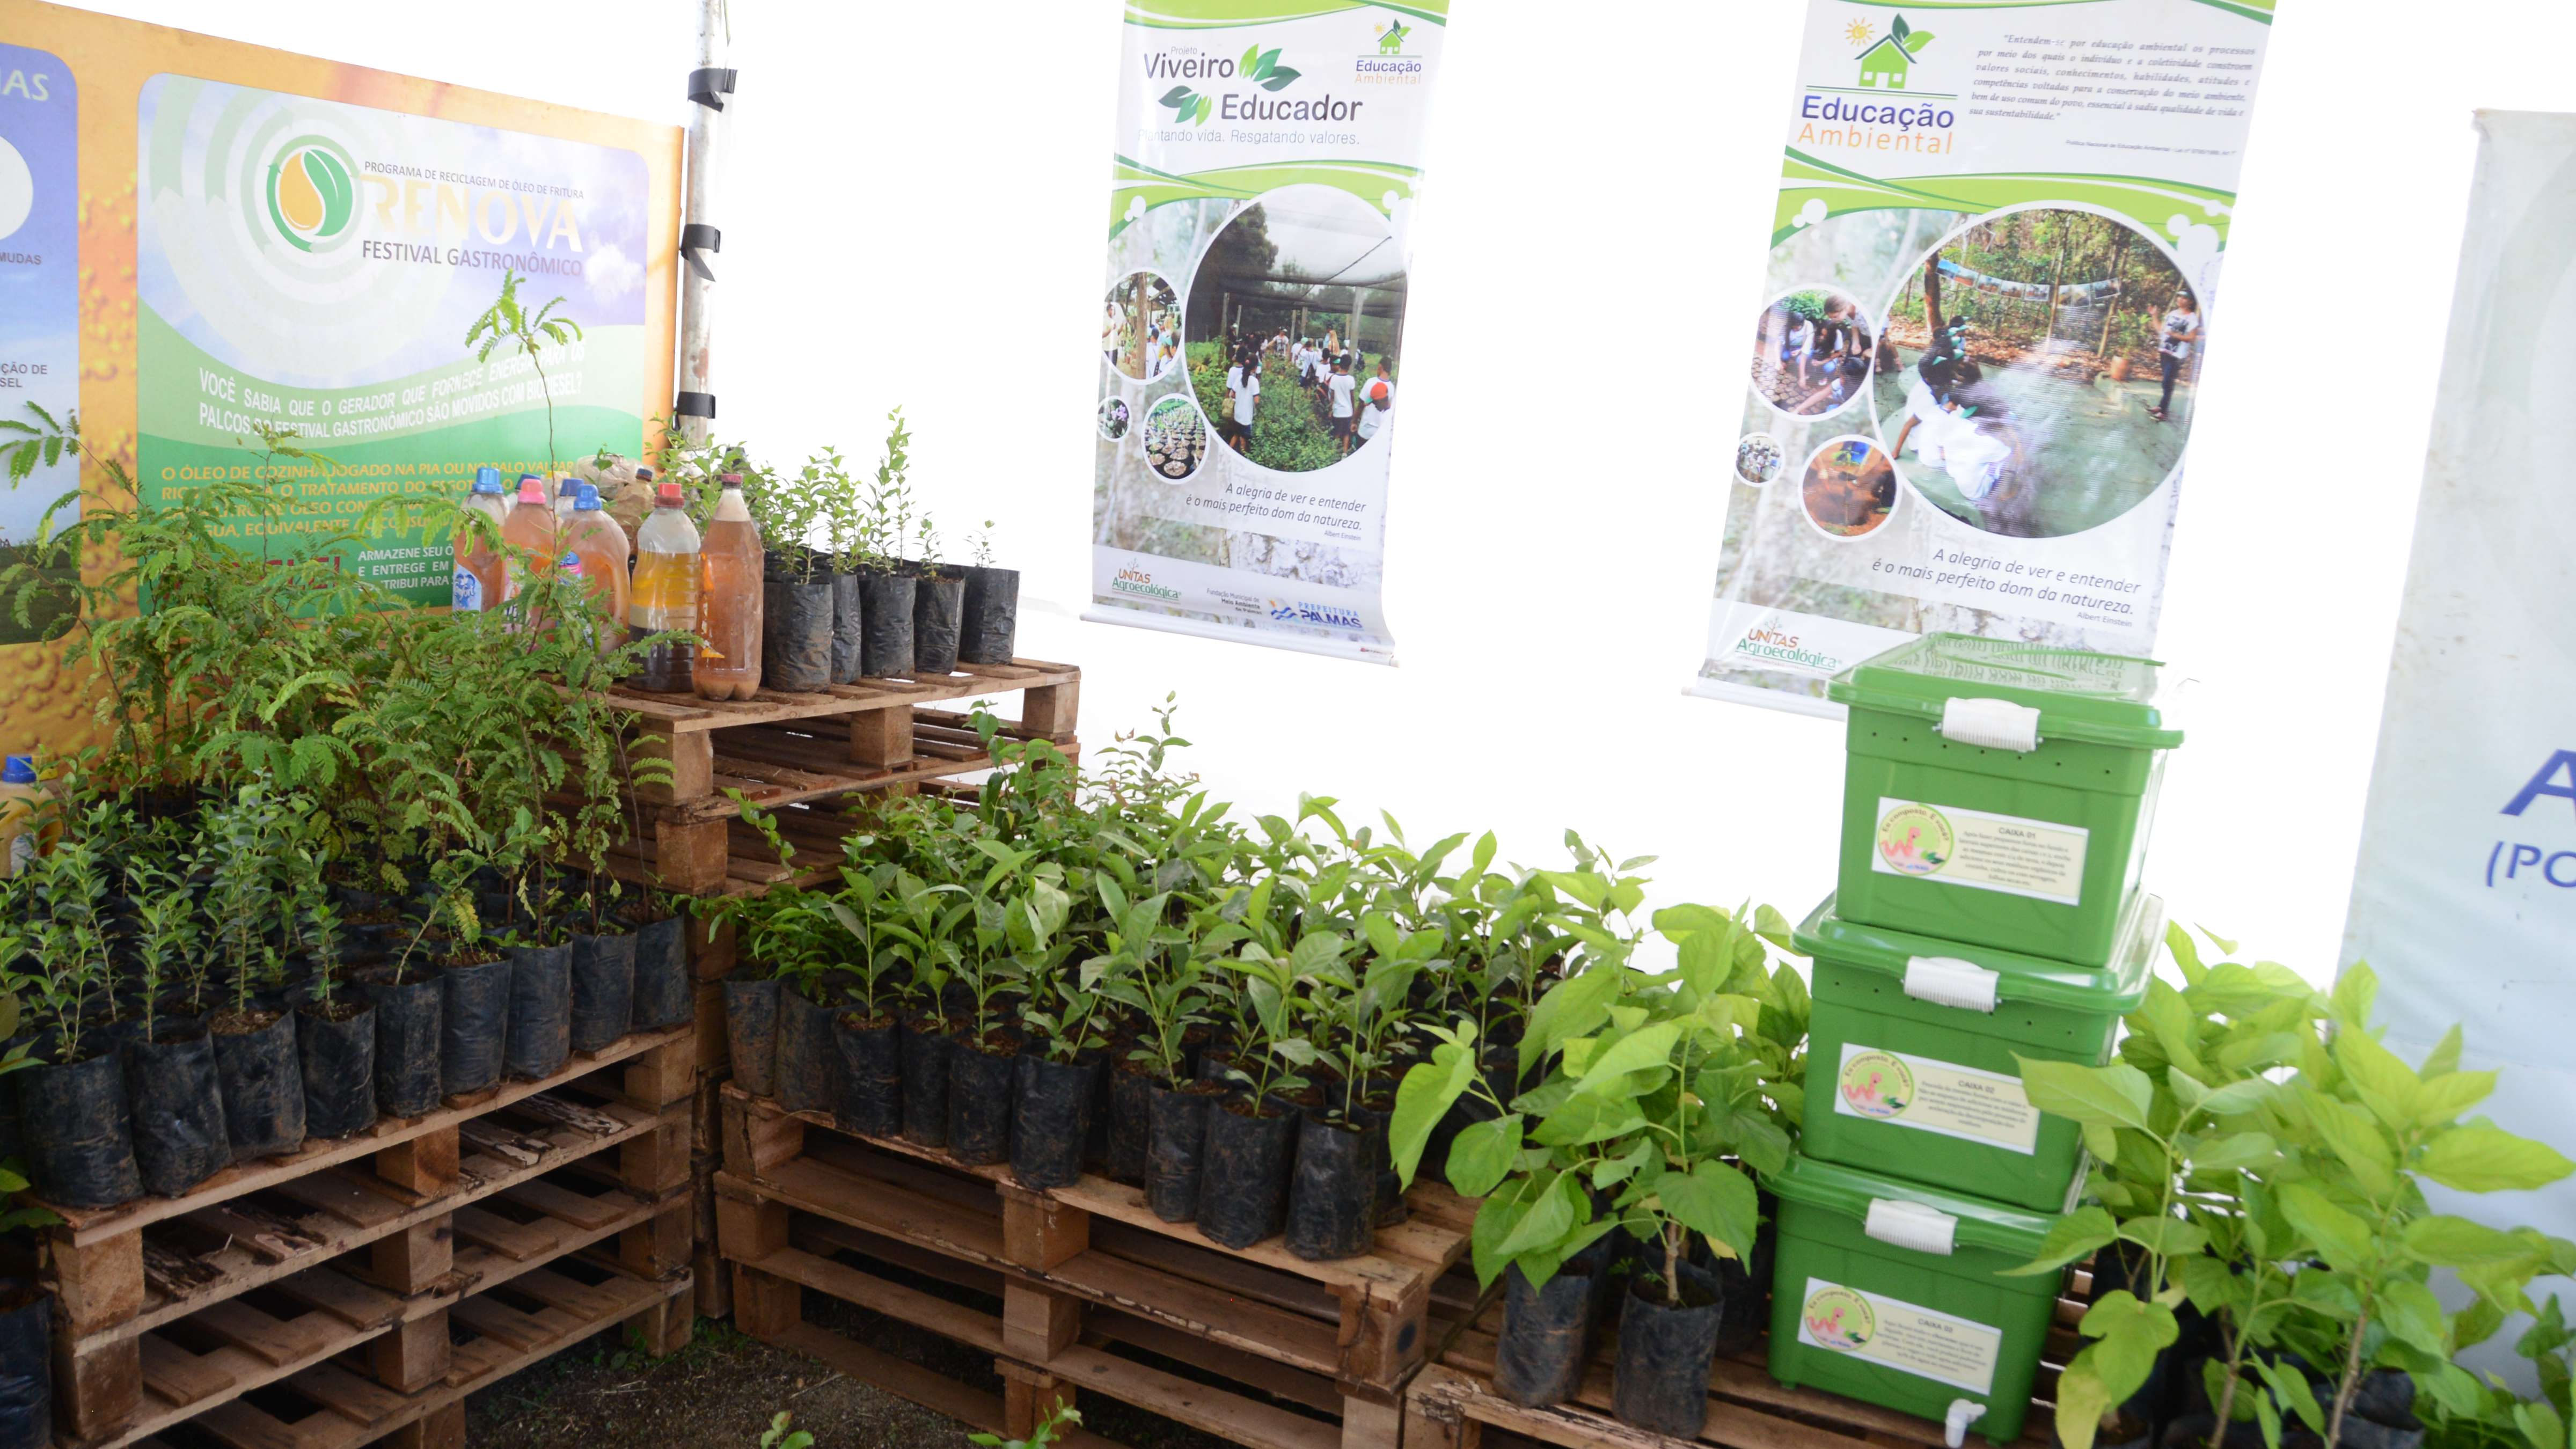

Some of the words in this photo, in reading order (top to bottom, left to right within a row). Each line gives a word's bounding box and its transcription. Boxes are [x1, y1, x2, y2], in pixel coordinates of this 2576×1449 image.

[1170, 46, 1197, 55] Projeto
[1978, 49, 1992, 58] por
[1997, 49, 2017, 58] meio
[2022, 50, 2037, 58] dos
[2042, 53, 2065, 62] quais
[2069, 39, 2086, 49] por
[2091, 39, 2134, 51] educação
[2140, 42, 2188, 52] ambiental
[2208, 46, 2256, 55] processos
[1144, 52, 1234, 79] Viveiro
[1356, 60, 1422, 75] Educação
[1976, 63, 2009, 72] valores
[2015, 65, 2050, 76] sociais,
[2055, 68, 2127, 80] conhecimentos,
[2134, 72, 2191, 84] habilidades,
[2198, 76, 2238, 85] atitudes
[1355, 73, 1421, 85] Ambiental
[1973, 78, 2029, 89] competências
[2033, 82, 2069, 91] voltadas
[2072, 85, 2092, 94] para
[2163, 89, 2174, 97] do
[2178, 90, 2200, 98] meio
[1220, 94, 1363, 121] Educador
[1802, 94, 1954, 132] Educação
[1971, 91, 1988, 100] bem
[2017, 96, 2047, 104] comum
[2050, 97, 2060, 105] do
[2061, 100, 2084, 108] povo,
[2087, 101, 2124, 110] essencial
[2160, 104, 2204, 115] qualidade
[1138, 129, 1193, 143] Plantando
[1197, 129, 1225, 143] vida.
[1231, 129, 1305, 145] Resgatando
[1310, 131, 1360, 145] valores.
[1797, 122, 1952, 155] Ambiental
[365, 162, 422, 178] PROGRAMA
[425, 170, 436, 180] DE
[440, 171, 496, 188] RECICLAGEM
[499, 179, 510, 189] DE
[512, 179, 535, 193] ÓLEO
[537, 184, 547, 194] DE
[550, 186, 584, 199] FRITURA
[360, 174, 583, 252] RENOVA
[0, 252, 42, 265] MUDAS
[362, 240, 442, 264] FESTIVAL
[447, 248, 582, 276] GASTRONÔMICO
[32, 365, 48, 374] DE
[200, 367, 236, 402] VOCÊ
[244, 388, 281, 413] SABIA
[289, 400, 314, 416] QUE
[322, 400, 331, 415] O
[339, 392, 396, 415] GERADOR
[402, 385, 426, 406] QUE
[432, 368, 484, 398] FORNECE
[540, 343, 566, 367] PARA
[200, 402, 251, 434] PALCOS
[333, 410, 424, 437] GASTRONÔMICO
[427, 399, 449, 423] SÃO
[452, 389, 499, 418] MOVIDOS
[502, 382, 525, 406] COM
[527, 371, 582, 401] BIODIESEL?
[162, 467, 176, 481] O
[180, 464, 226, 480] ÓLEO
[230, 466, 251, 479] DE
[328, 464, 392, 477] JOGADO
[395, 463, 415, 475] NA
[419, 463, 441, 475] PIA
[444, 462, 464, 474] OU
[281, 485, 293, 497] O
[299, 481, 399, 495] TRATAMENTO
[405, 480, 426, 493] DO
[1226, 483, 1233, 493] A
[1236, 484, 1272, 499] alegria
[1275, 489, 1287, 501] de
[1290, 493, 1307, 504] ver
[1309, 497, 1315, 506] e
[1318, 497, 1366, 512] entender
[1186, 494, 1192, 505] é
[1194, 497, 1201, 506] o
[1203, 499, 1226, 510] mais
[1228, 502, 1269, 516] perfeito
[1271, 507, 1294, 520] dom
[1297, 510, 1311, 522] da
[1314, 515, 1362, 530] natureza.
[357, 547, 421, 561] ARMAZENE
[423, 546, 443, 558] SEU
[358, 566, 365, 577] E
[372, 562, 426, 576] ENTREGE
[433, 561, 449, 571] EM
[1118, 568, 1151, 584] UNITAS
[1933, 548, 1945, 561] A
[1949, 550, 2001, 571] alegria
[2005, 560, 2024, 574] de
[2029, 566, 2053, 580] ver
[2056, 572, 2066, 581] e
[2069, 573, 2141, 595] entender
[420, 576, 450, 587] PARA
[1872, 558, 1881, 571] é
[1885, 562, 1894, 573] o
[1898, 565, 1934, 581] mais
[1936, 571, 1995, 591] perfeito
[1999, 580, 2033, 597] dom
[2038, 587, 2058, 601] da
[2061, 593, 2134, 616] natureza.
[1298, 601, 1359, 617] PREFEITURA
[1299, 609, 1363, 628] PALMAS
[2076, 611, 2101, 622] Albert
[2102, 616, 2133, 627] Einstein
[1748, 628, 1799, 648] UNITAS
[1737, 638, 1838, 668] Agroecológica
[2498, 749, 2576, 825] A
[1999, 827, 2024, 838] CAIXA
